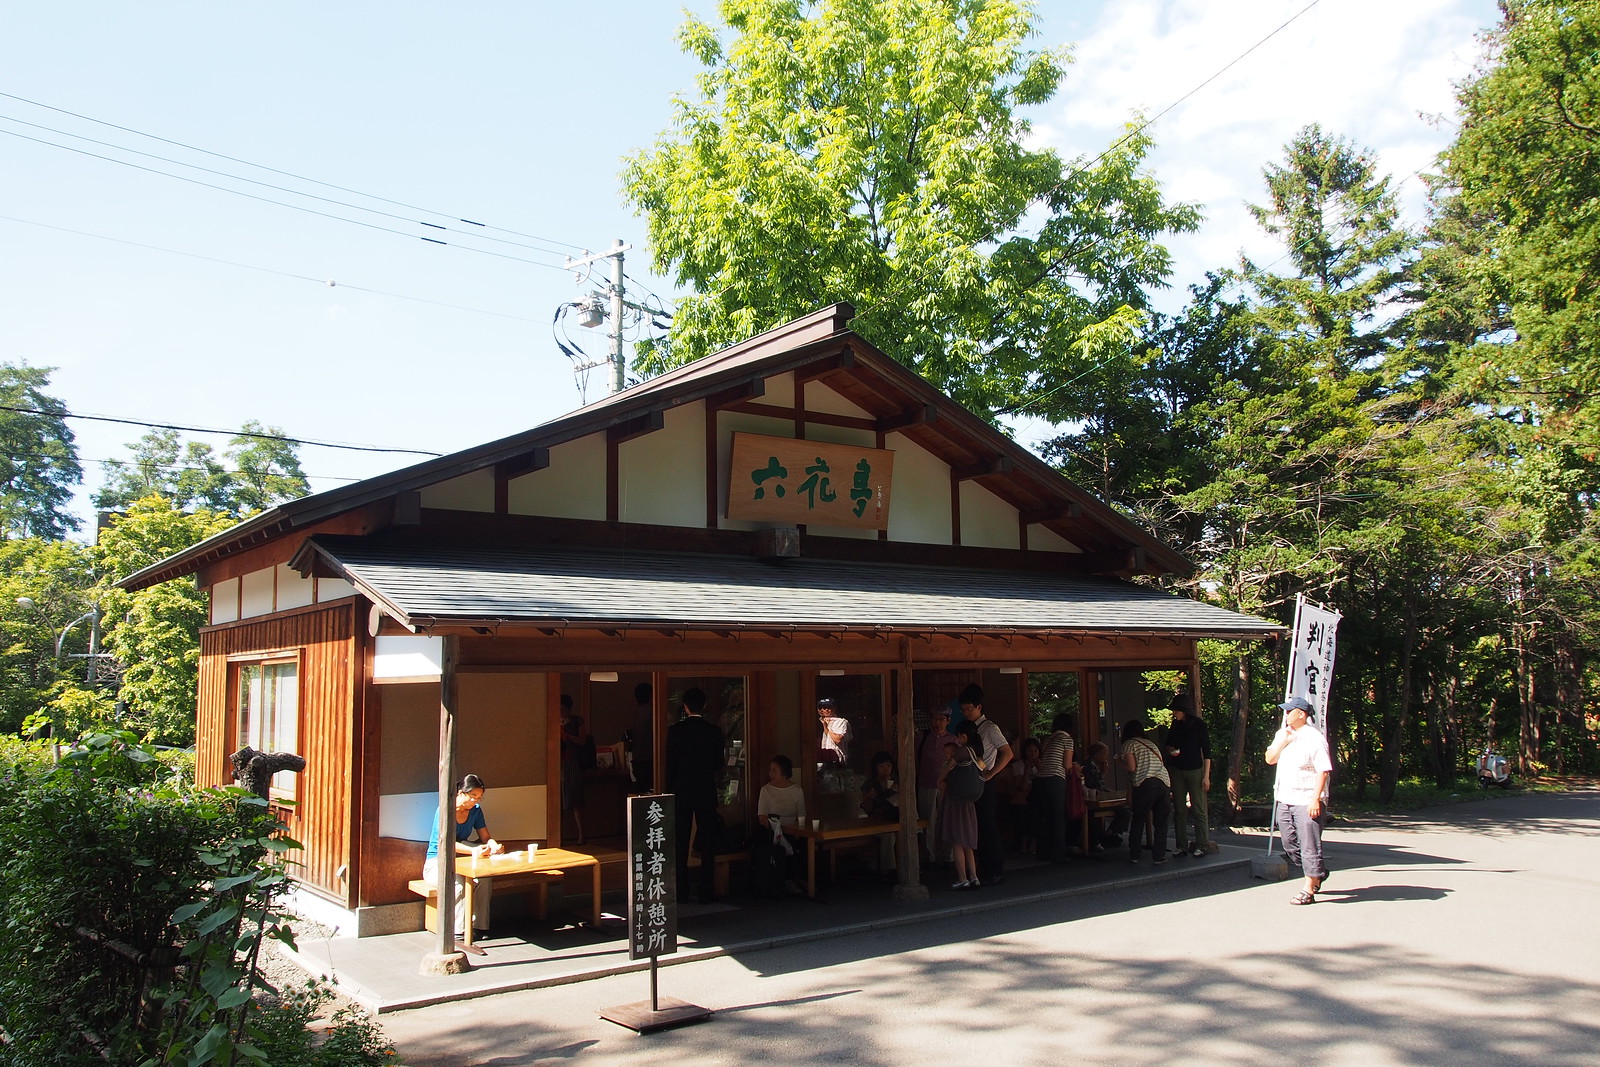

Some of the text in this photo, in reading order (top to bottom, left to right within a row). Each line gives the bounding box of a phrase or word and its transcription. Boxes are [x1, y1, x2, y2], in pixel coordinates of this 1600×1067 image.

[751, 456, 873, 519] 六花亭
[645, 800, 668, 952] 参拝者休憩所
